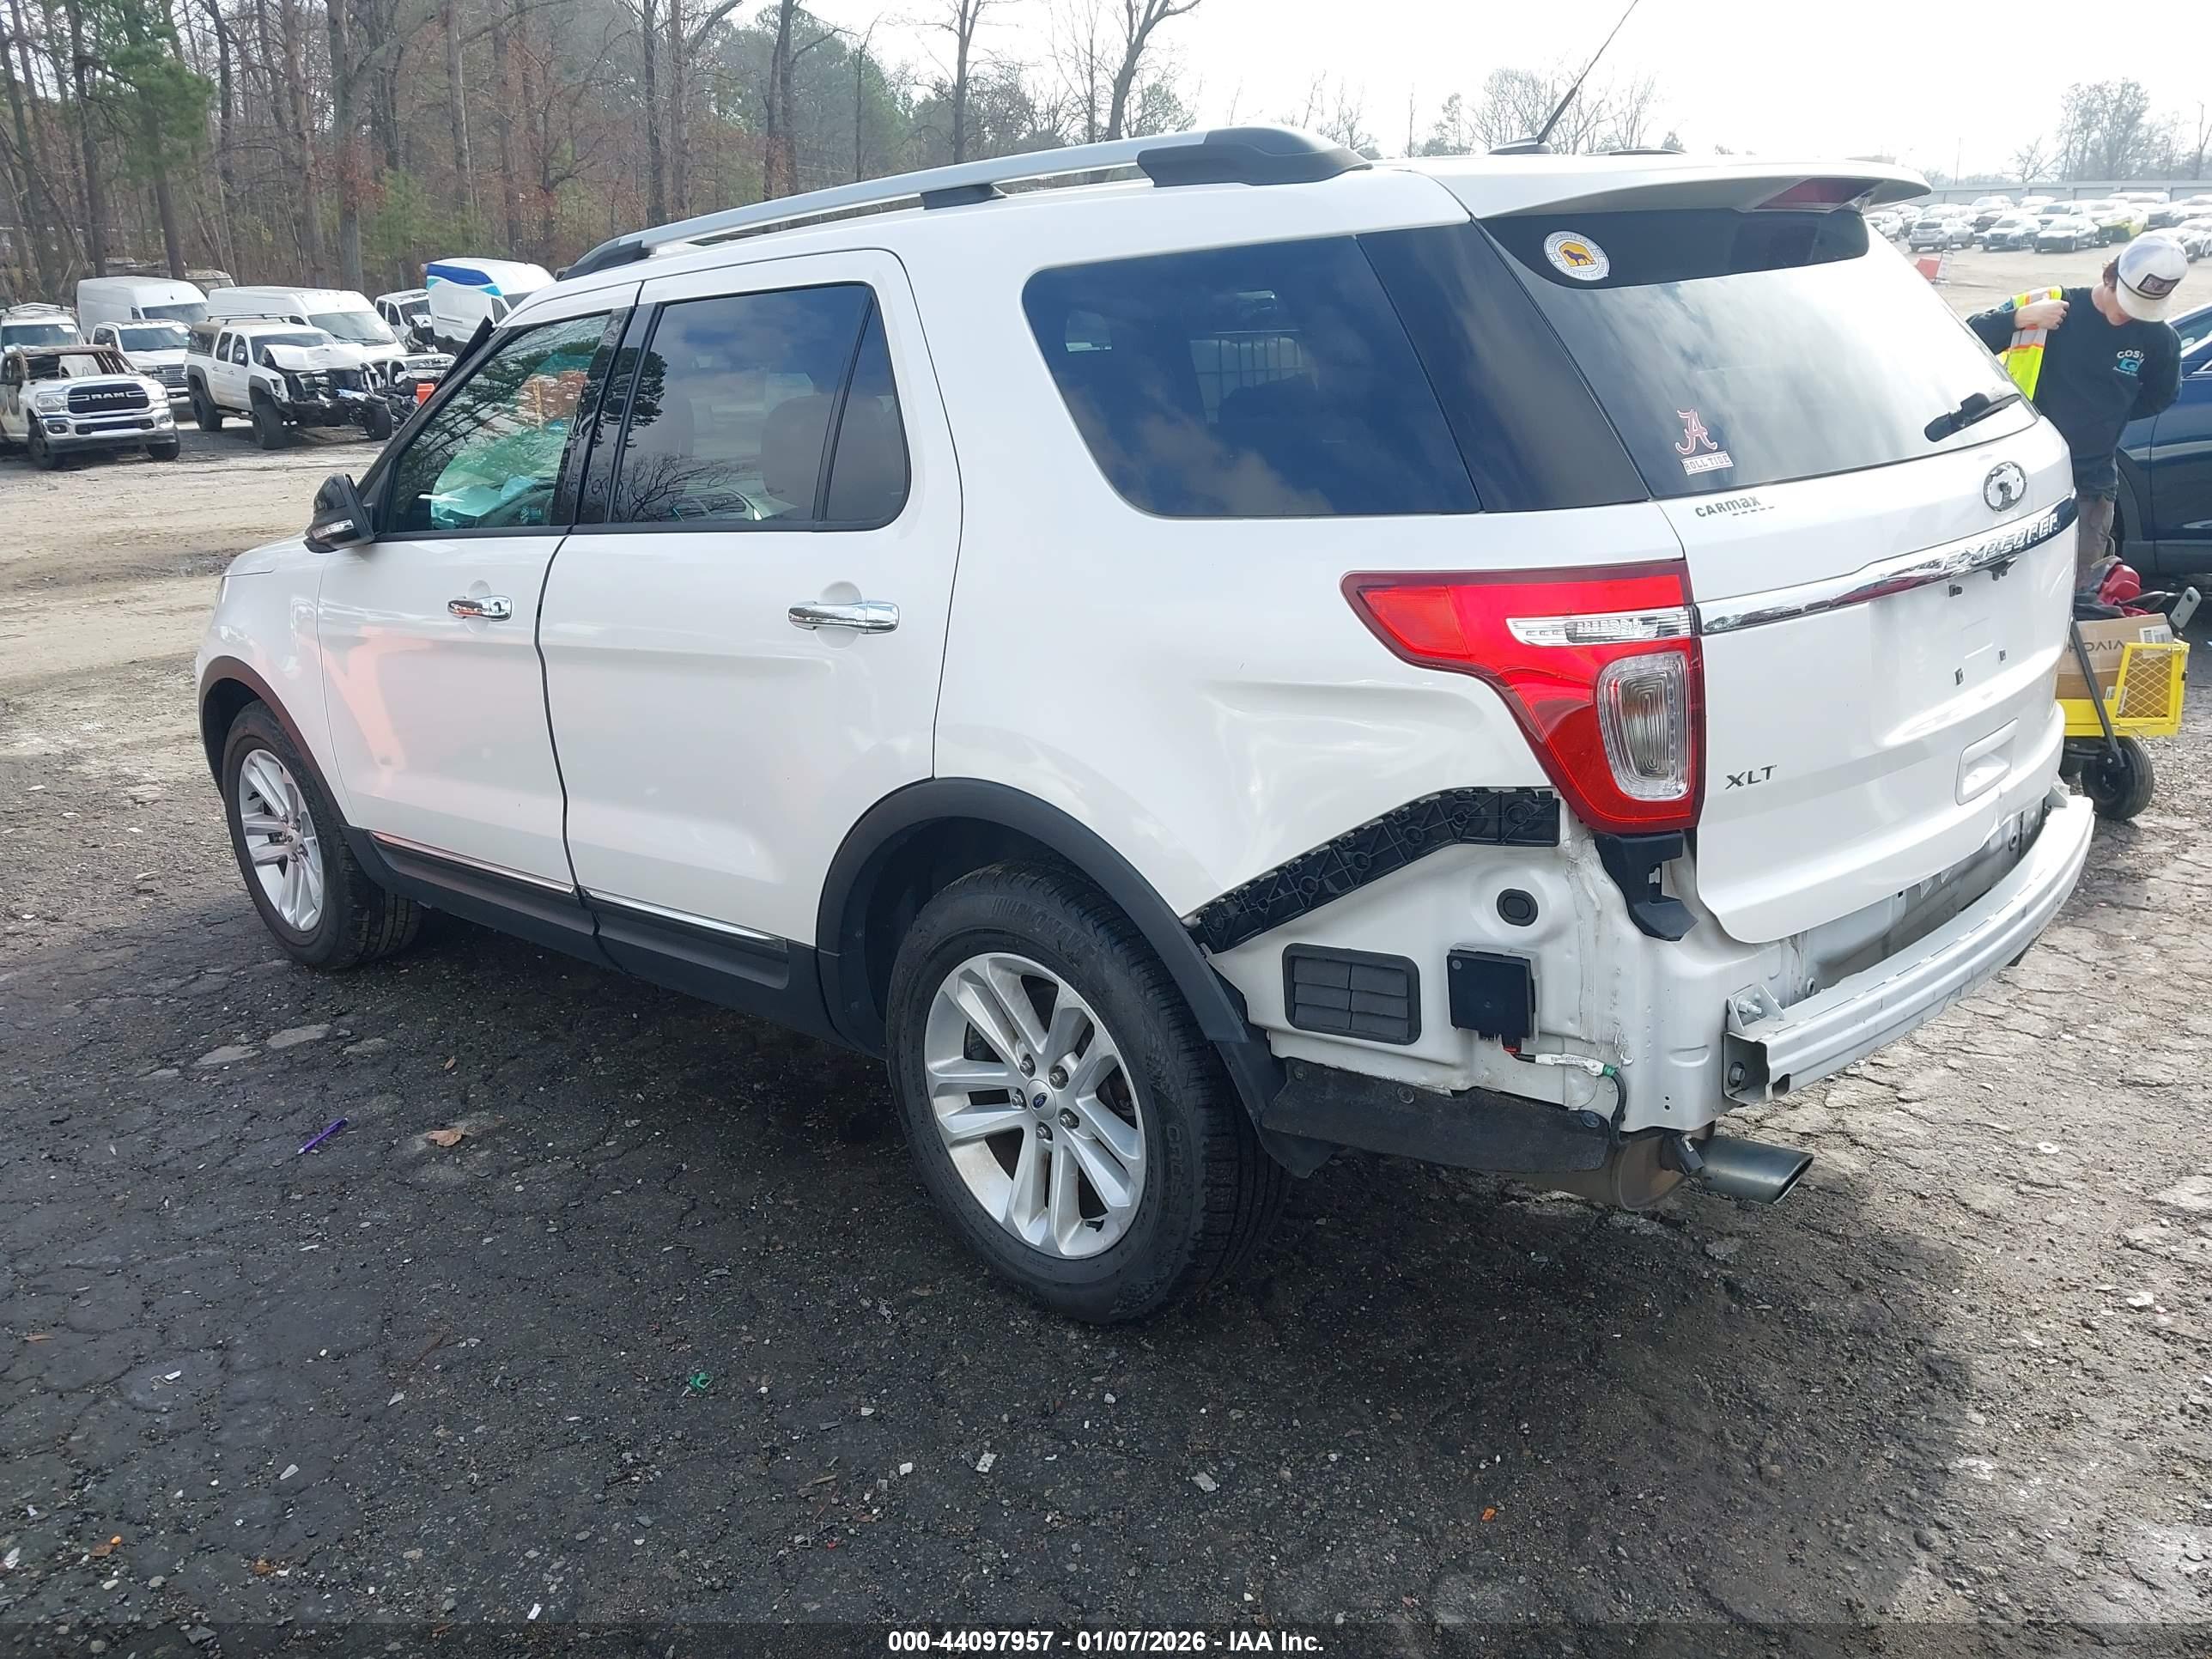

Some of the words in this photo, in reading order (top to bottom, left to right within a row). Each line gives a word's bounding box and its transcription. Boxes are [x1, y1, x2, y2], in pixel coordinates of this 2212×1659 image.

[90, 392, 125, 400] RAM
[1675, 408, 1717, 454] A
[1683, 457, 1708, 471] ROLL
[1708, 454, 1729, 465] TIDE
[1725, 764, 1778, 790] XLT
